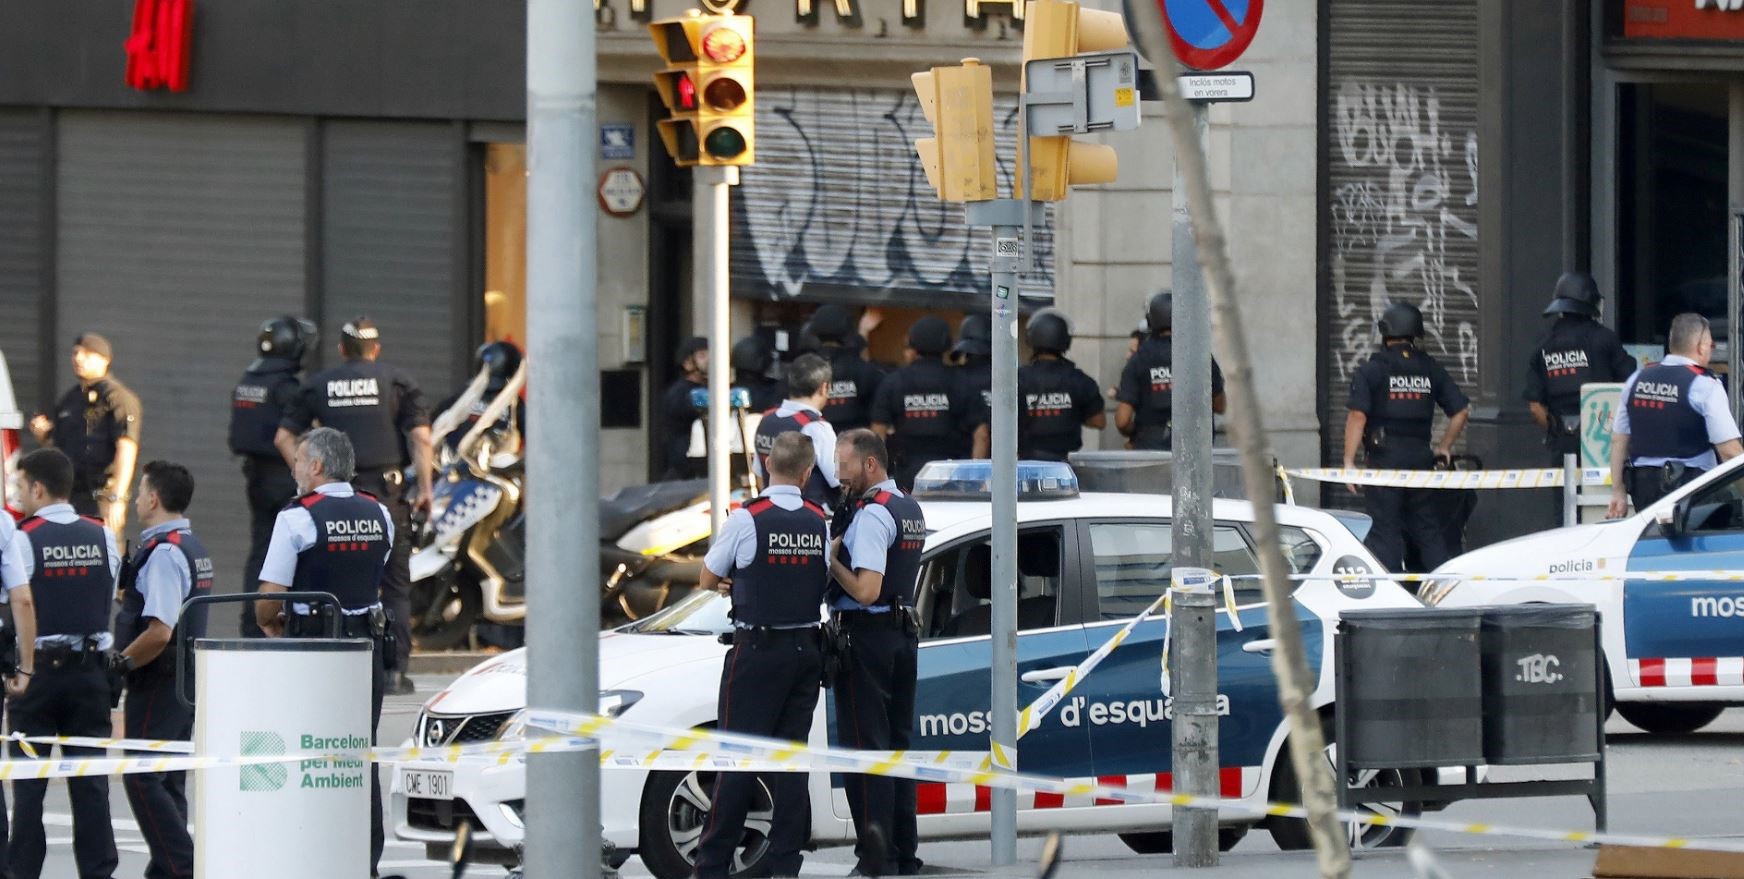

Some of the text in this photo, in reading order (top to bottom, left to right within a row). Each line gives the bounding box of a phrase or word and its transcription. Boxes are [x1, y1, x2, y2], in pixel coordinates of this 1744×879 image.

[1213, 78, 1236, 86] motos
[1541, 349, 1588, 367] POLICIA
[327, 378, 379, 397] POLICIA
[1389, 375, 1432, 389] POLICIA
[1636, 381, 1679, 397] POLICIA
[904, 394, 949, 408] POLICIA
[326, 519, 383, 534] POLICIA
[902, 519, 926, 533] POLICIA
[768, 533, 823, 548] POLICIA
[42, 544, 101, 560] POLICIA
[1549, 559, 1593, 574] policia
[300, 773, 363, 789] Ambient
[405, 773, 448, 795] CME 1901
